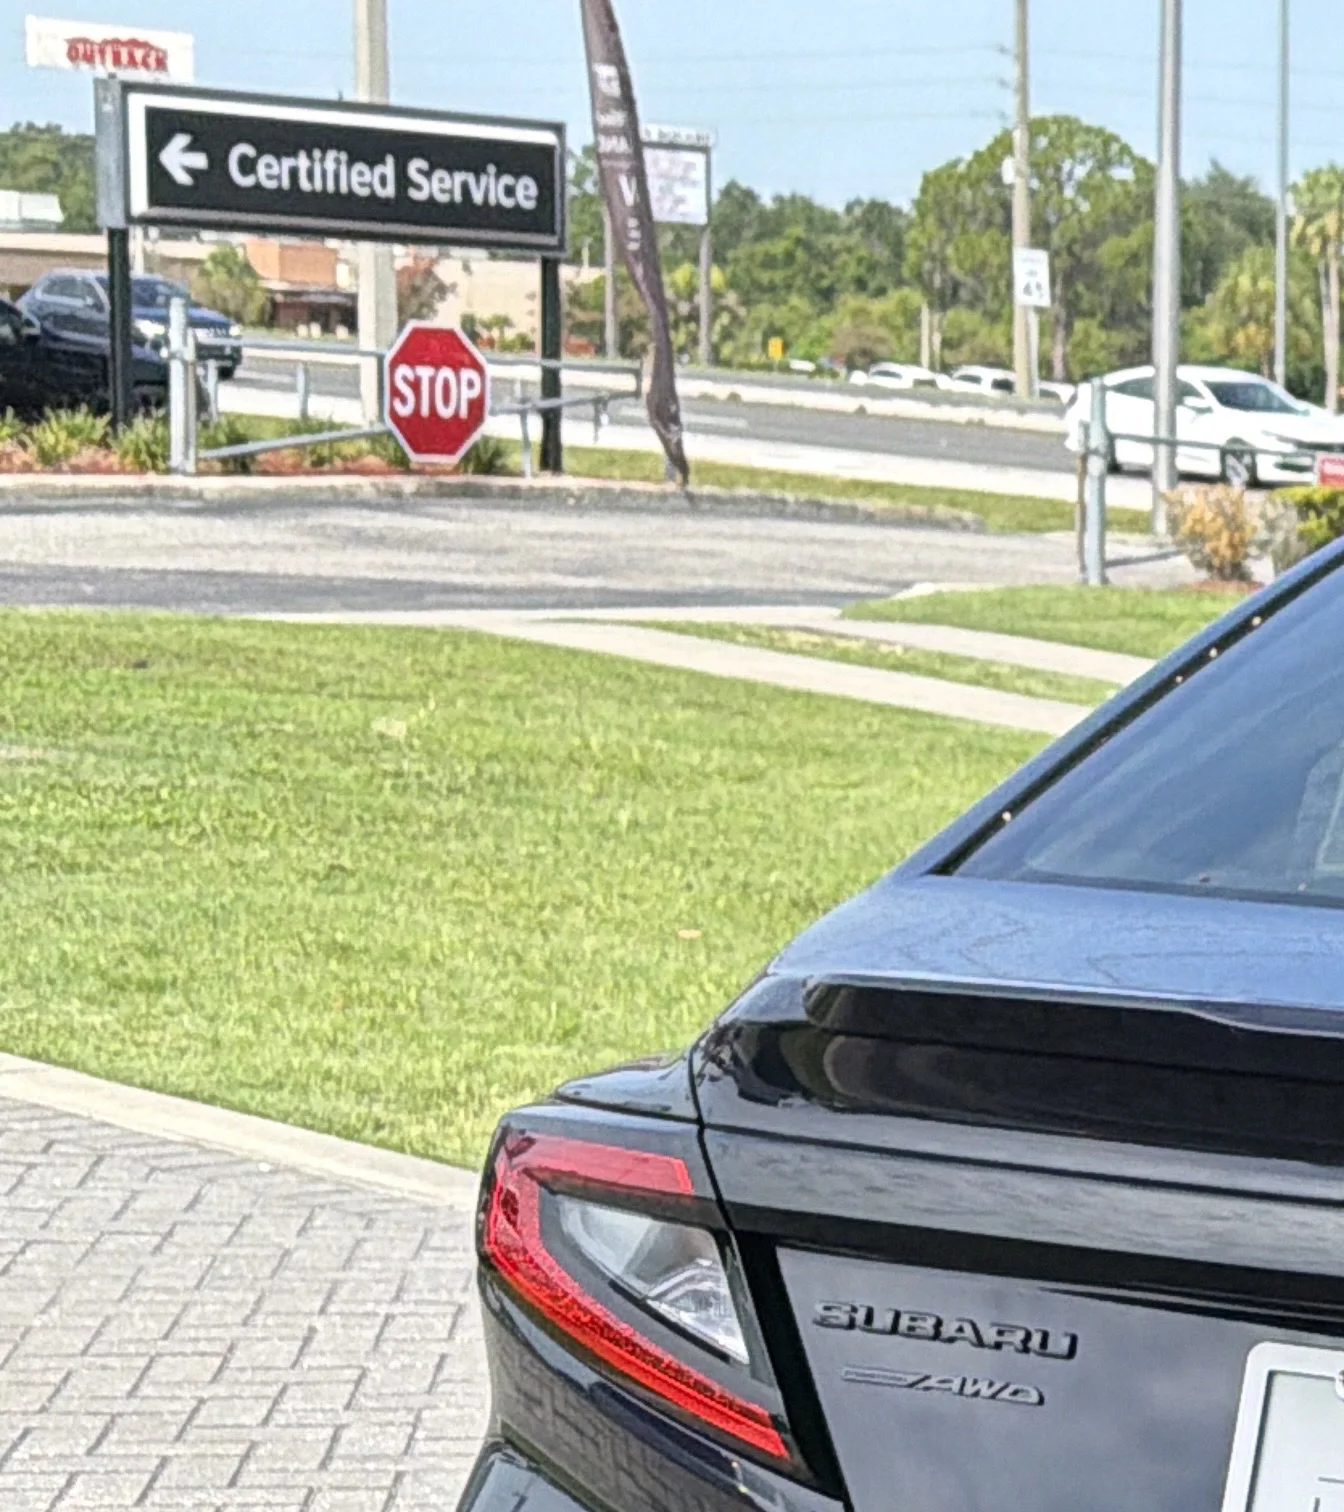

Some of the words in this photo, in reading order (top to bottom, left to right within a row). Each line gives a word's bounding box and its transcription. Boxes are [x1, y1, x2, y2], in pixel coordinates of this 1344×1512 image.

[228, 143, 396, 199] Certified
[407, 157, 539, 210] Service
[392, 364, 482, 420] STOP
[812, 1300, 1079, 1360] SUBARU
[913, 1374, 1045, 1406] AWD
